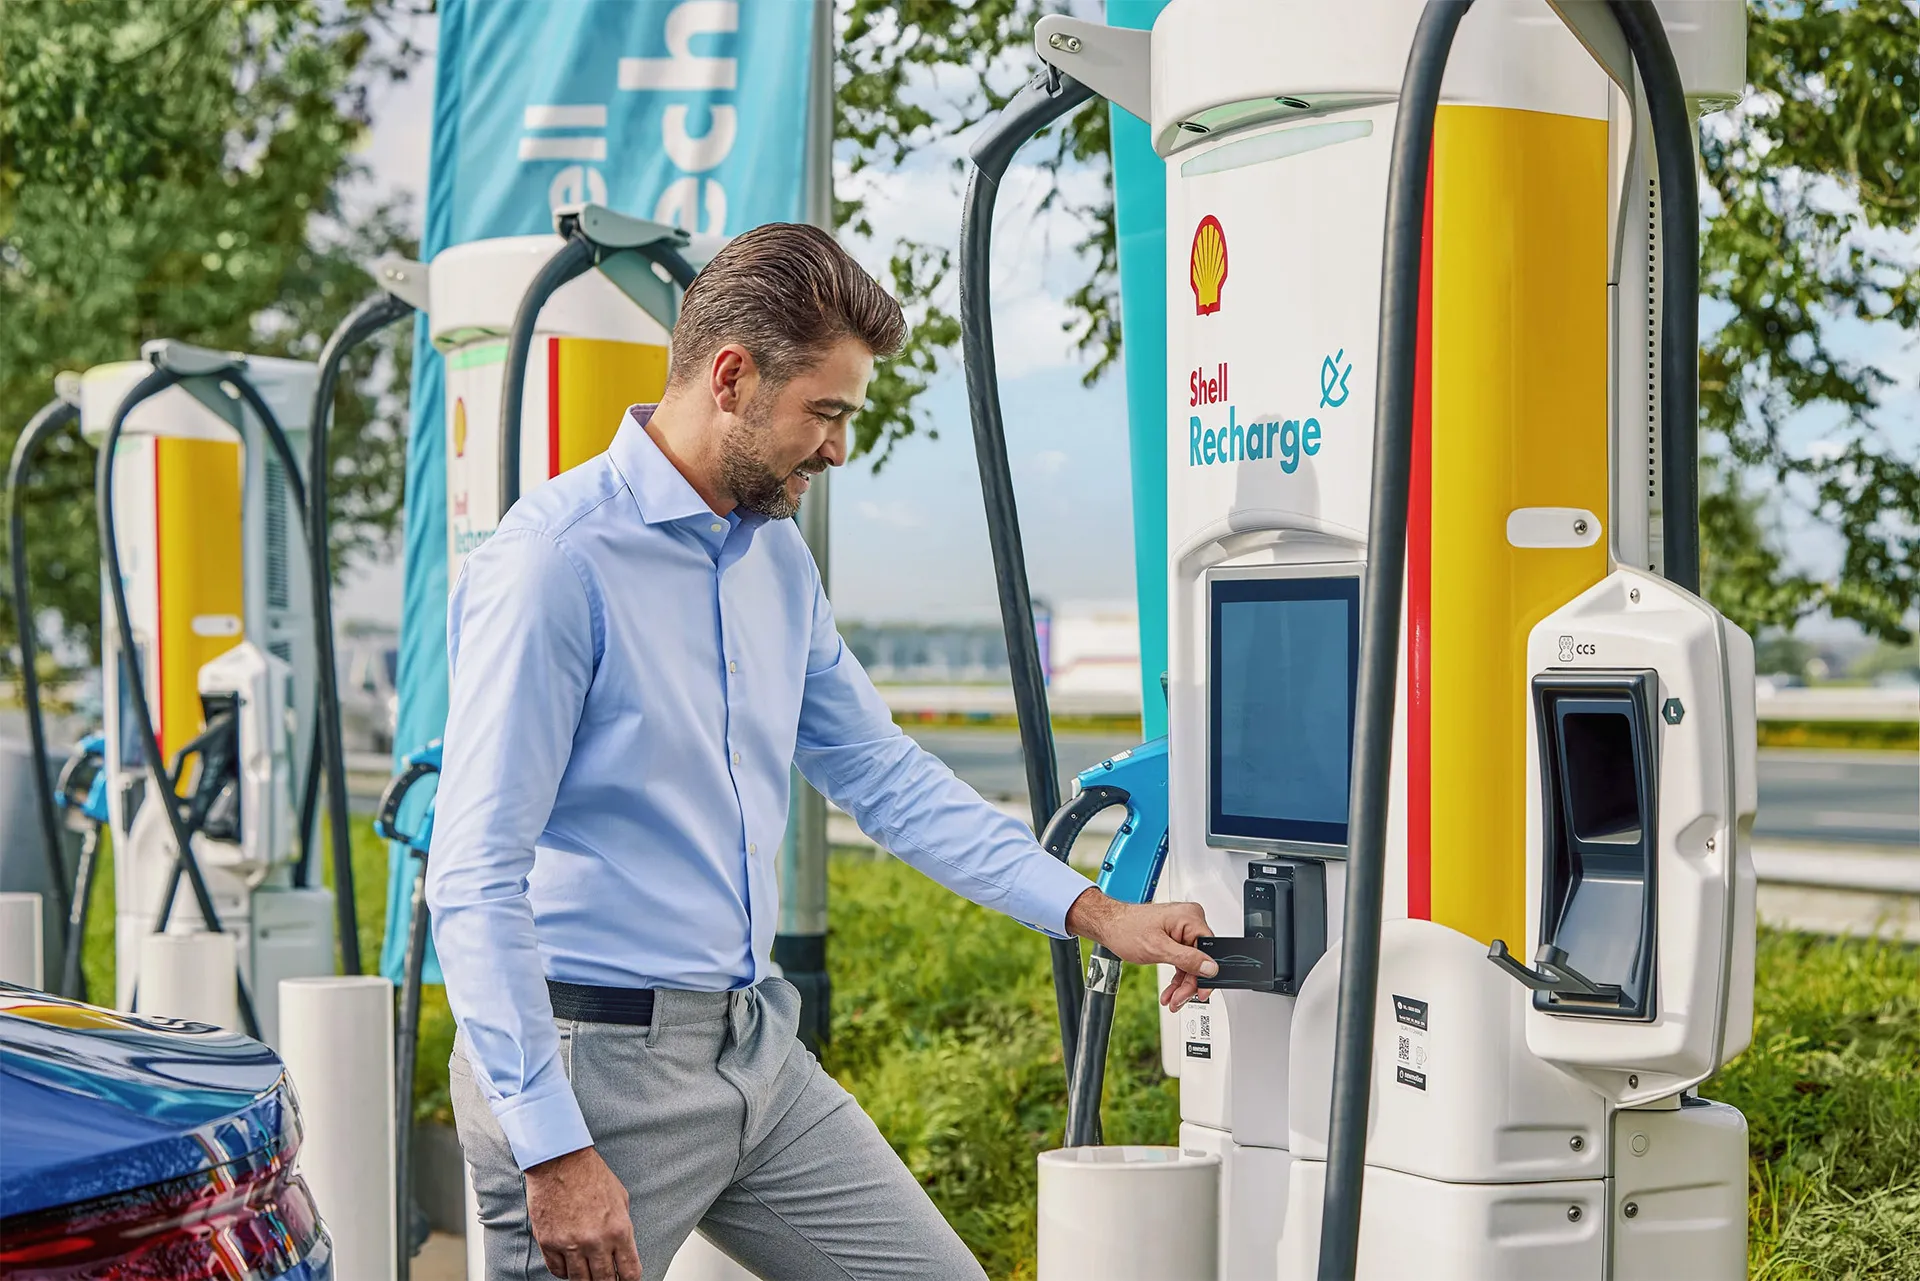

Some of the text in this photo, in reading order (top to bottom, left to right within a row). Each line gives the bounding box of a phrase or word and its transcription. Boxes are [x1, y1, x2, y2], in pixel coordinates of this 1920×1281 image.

[617, 0, 739, 238] ech
[518, 105, 607, 208] ell
[1190, 362, 1228, 407] Shell
[1190, 405, 1322, 475] Recharge
[1576, 644, 1596, 655] CCS
[1670, 706, 1677, 717] L
